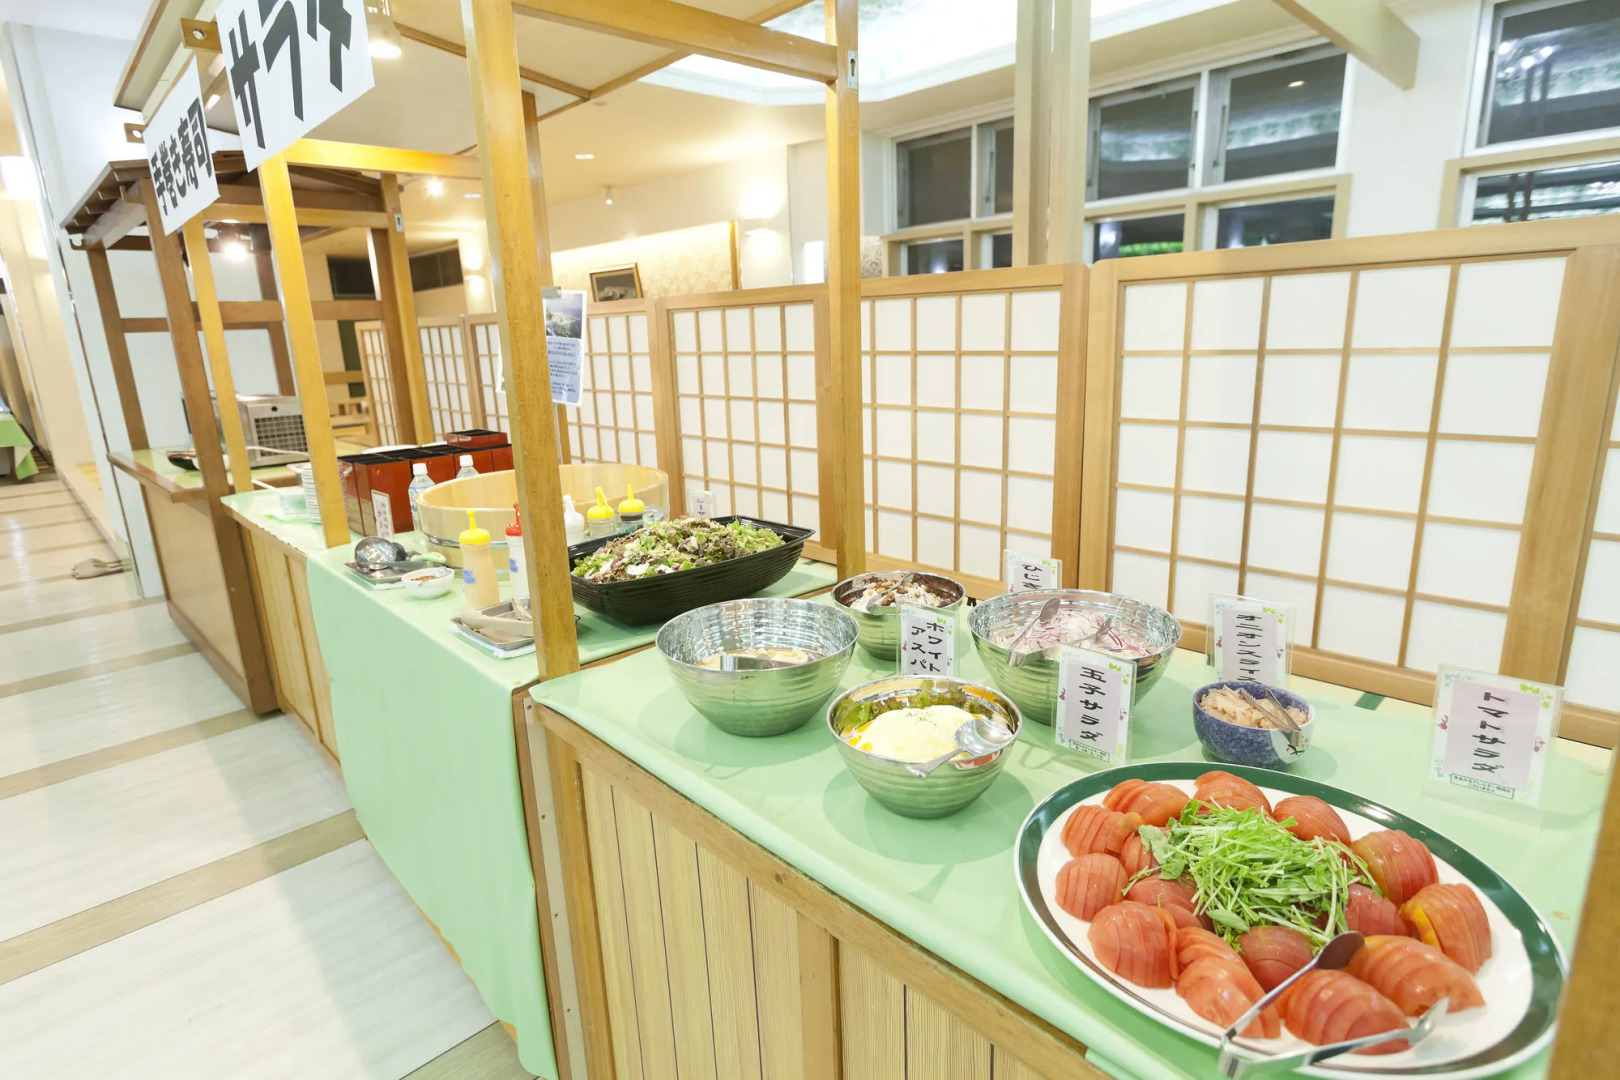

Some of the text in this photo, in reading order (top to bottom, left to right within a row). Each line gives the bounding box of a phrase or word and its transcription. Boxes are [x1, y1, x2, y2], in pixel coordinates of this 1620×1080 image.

[150, 97, 213, 217] 手巻き寿司
[910, 625, 927, 676] アスパ
[926, 622, 945, 672] ホワイト
[1235, 613, 1264, 685] オニオンスライス
[1078, 665, 1107, 742] 玉子サラダ
[1471, 691, 1510, 774] トマトサラダ
